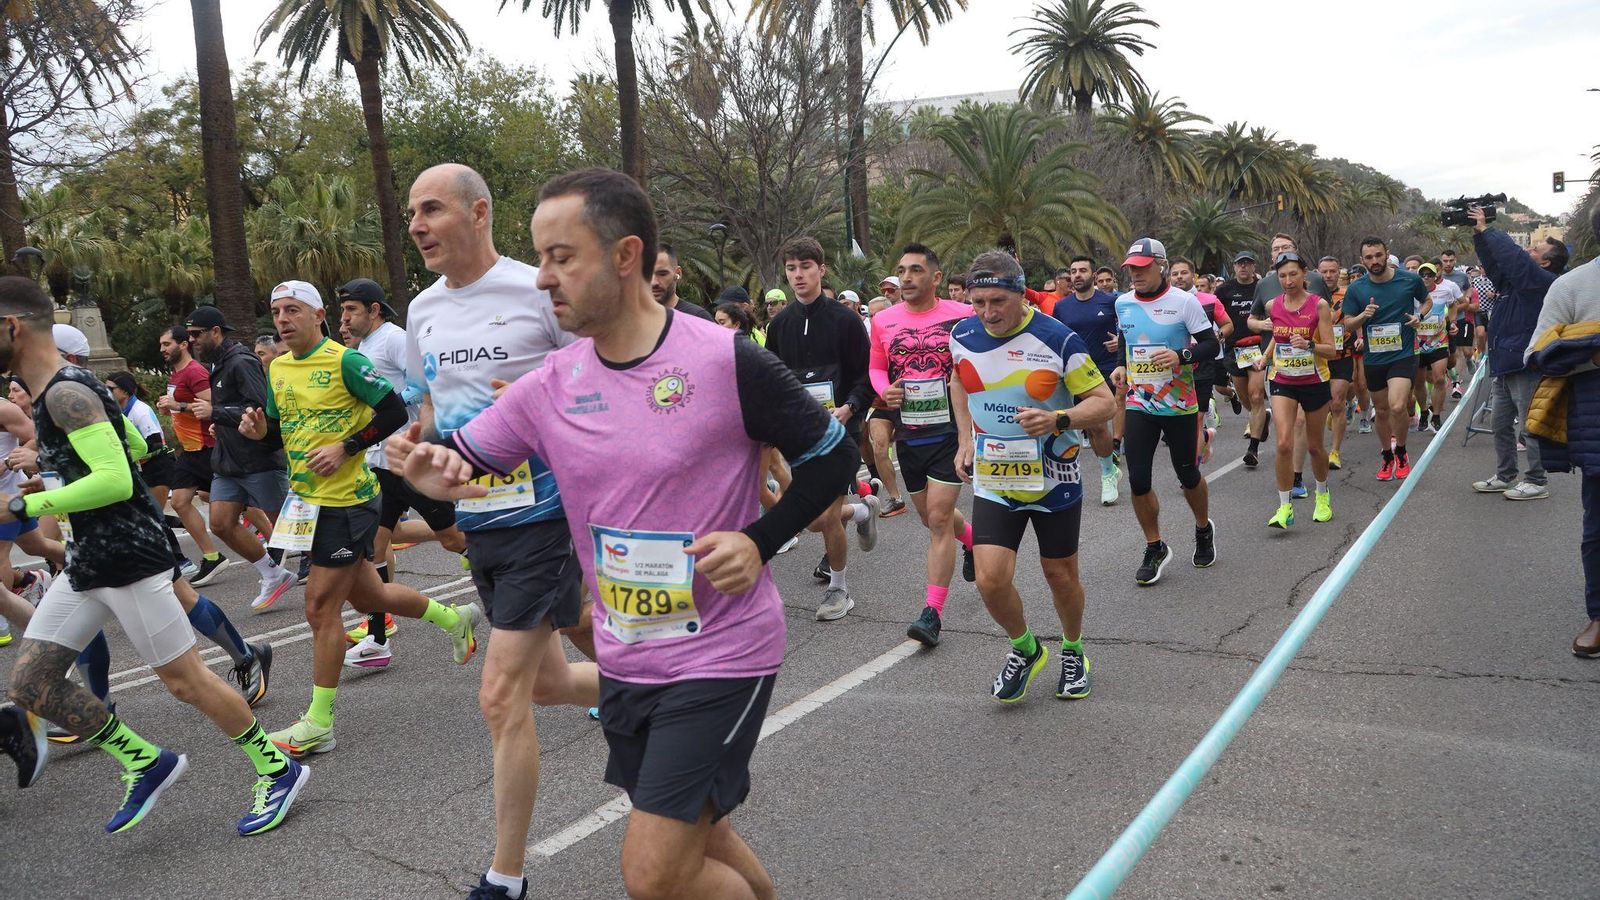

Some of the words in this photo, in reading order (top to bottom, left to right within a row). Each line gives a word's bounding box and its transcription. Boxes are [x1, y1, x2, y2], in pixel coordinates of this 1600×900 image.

[1376, 337, 1397, 345] 1854
[439, 346, 509, 366] FIDIAS
[990, 463, 1032, 476] 2719
[644, 569, 669, 577] MÁLAGA
[610, 583, 672, 616] 1789
